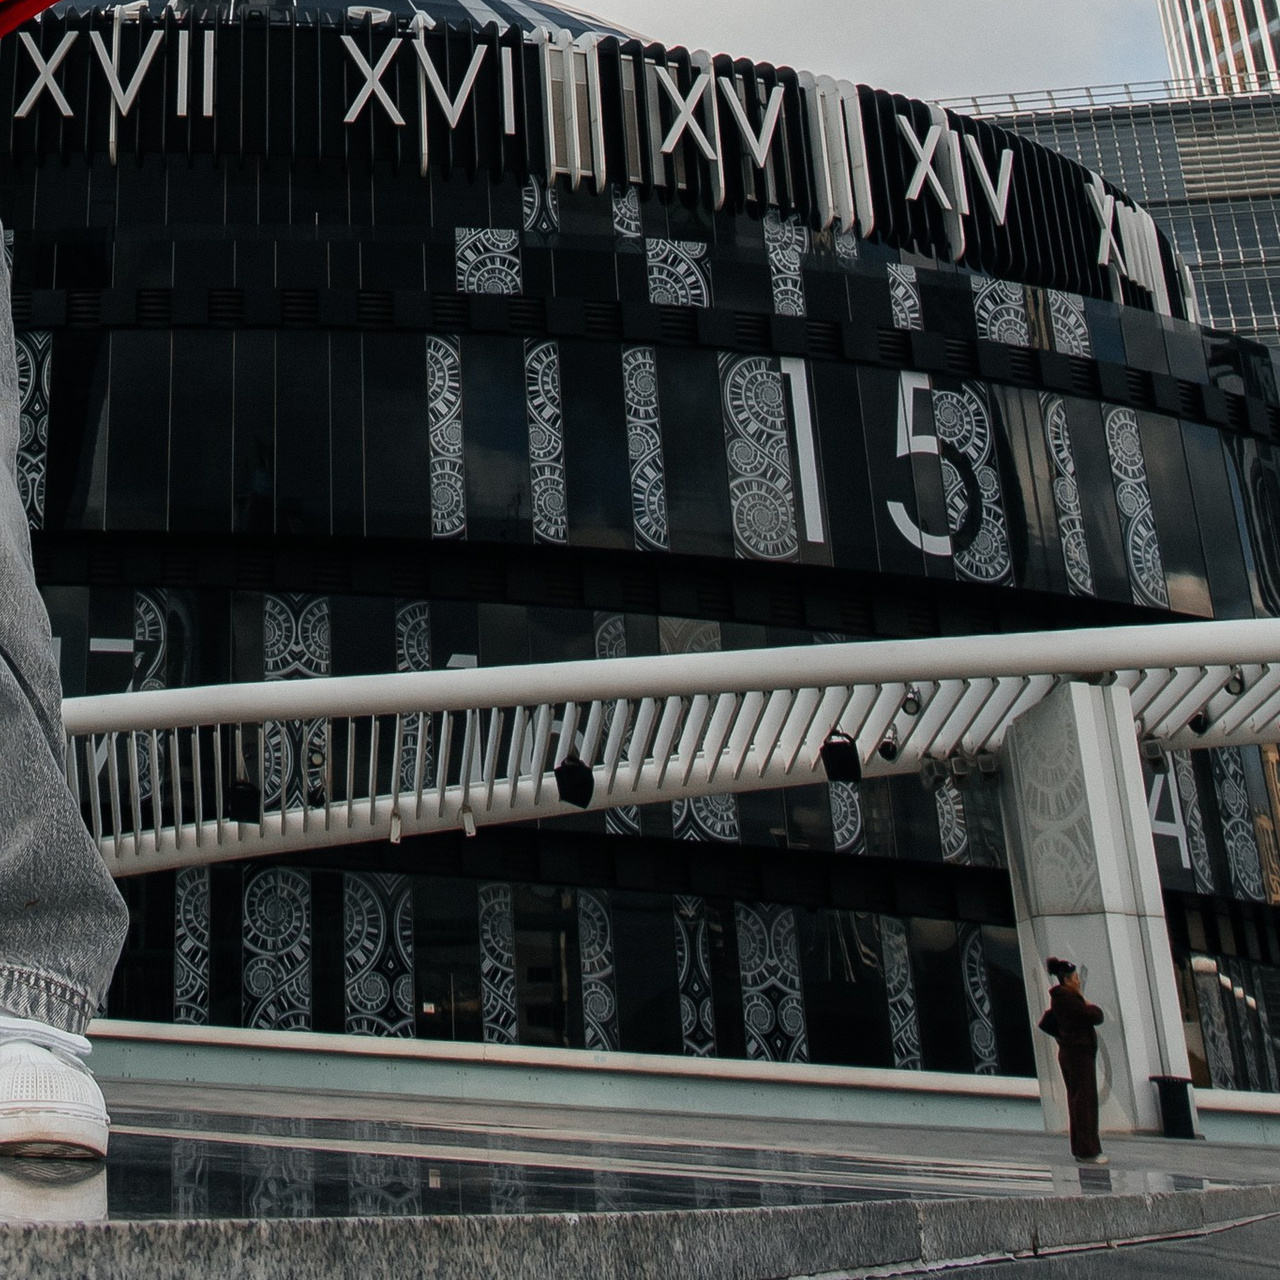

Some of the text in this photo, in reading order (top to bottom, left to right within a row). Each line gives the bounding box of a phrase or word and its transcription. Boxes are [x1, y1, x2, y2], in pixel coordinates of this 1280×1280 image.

[14, 30, 215, 118] XVII
[340, 35, 516, 135] XVI
[780, 357, 983, 557] 15
